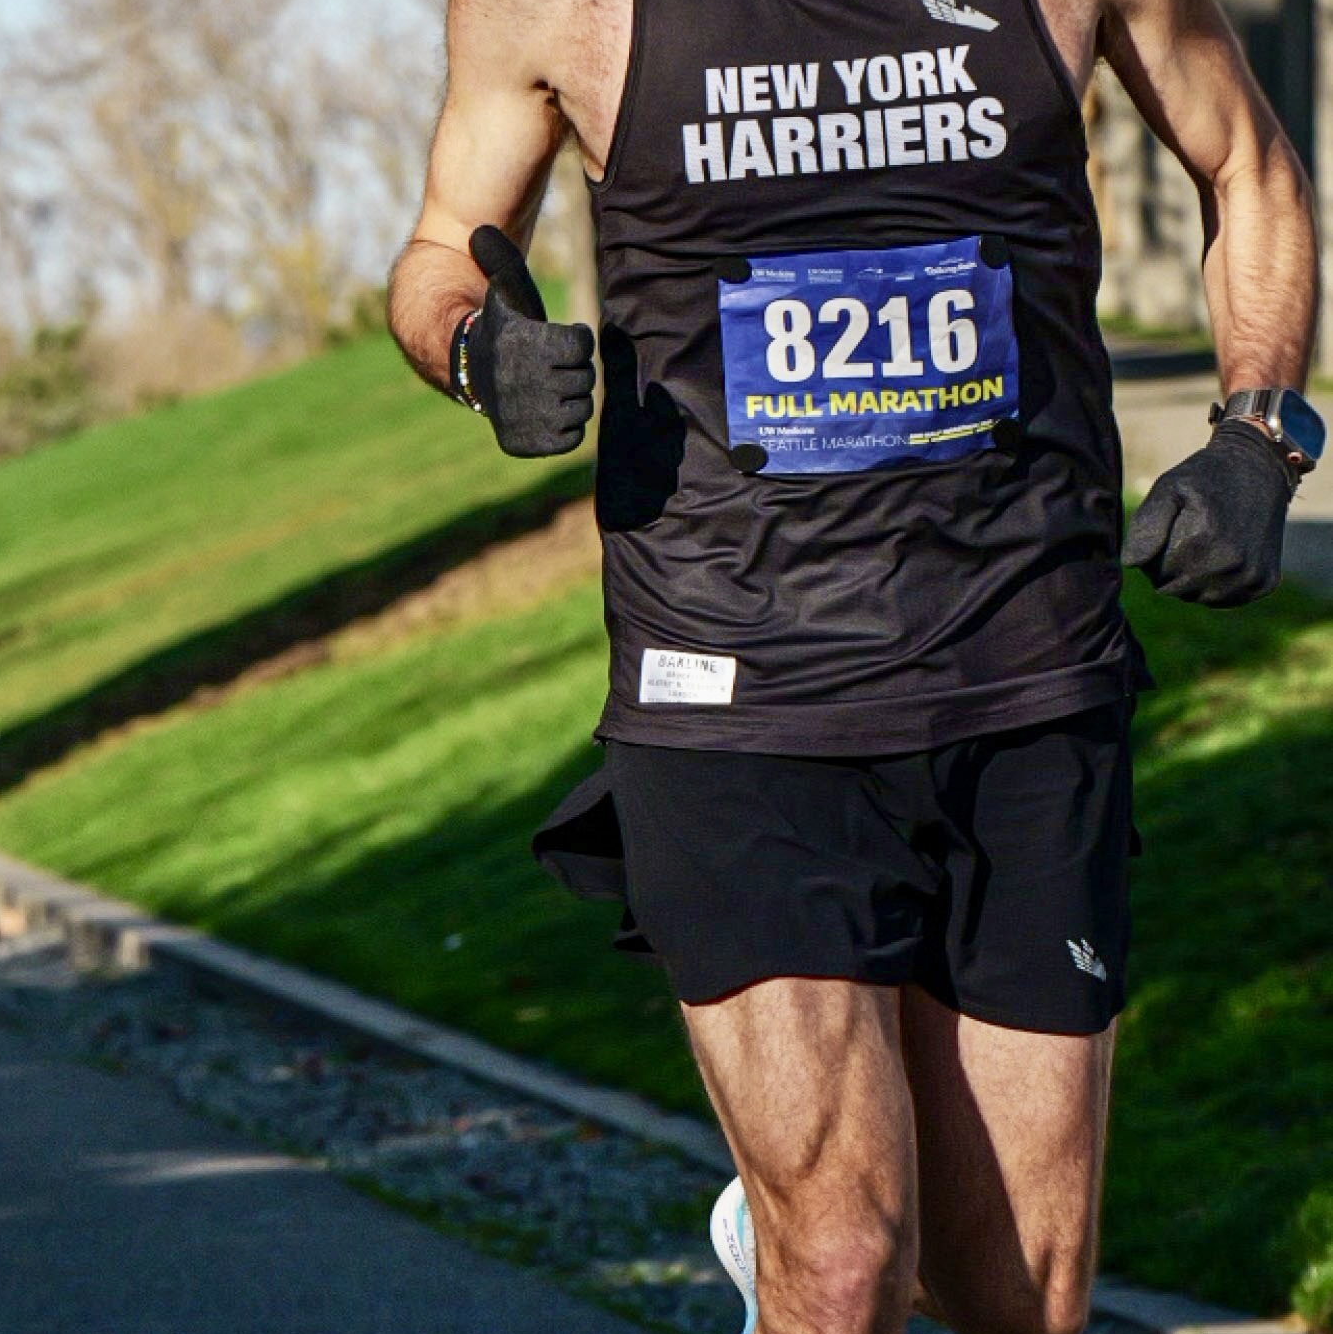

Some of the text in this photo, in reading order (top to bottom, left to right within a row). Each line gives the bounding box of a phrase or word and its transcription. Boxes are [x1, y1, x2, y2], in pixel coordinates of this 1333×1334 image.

[705, 44, 978, 116] NEW YORK
[682, 96, 1009, 184] HARRIERS
[764, 289, 979, 383] 8216
[746, 375, 1004, 420] FULL MARATHON
[760, 433, 907, 452] SEATTLE MARATHON
